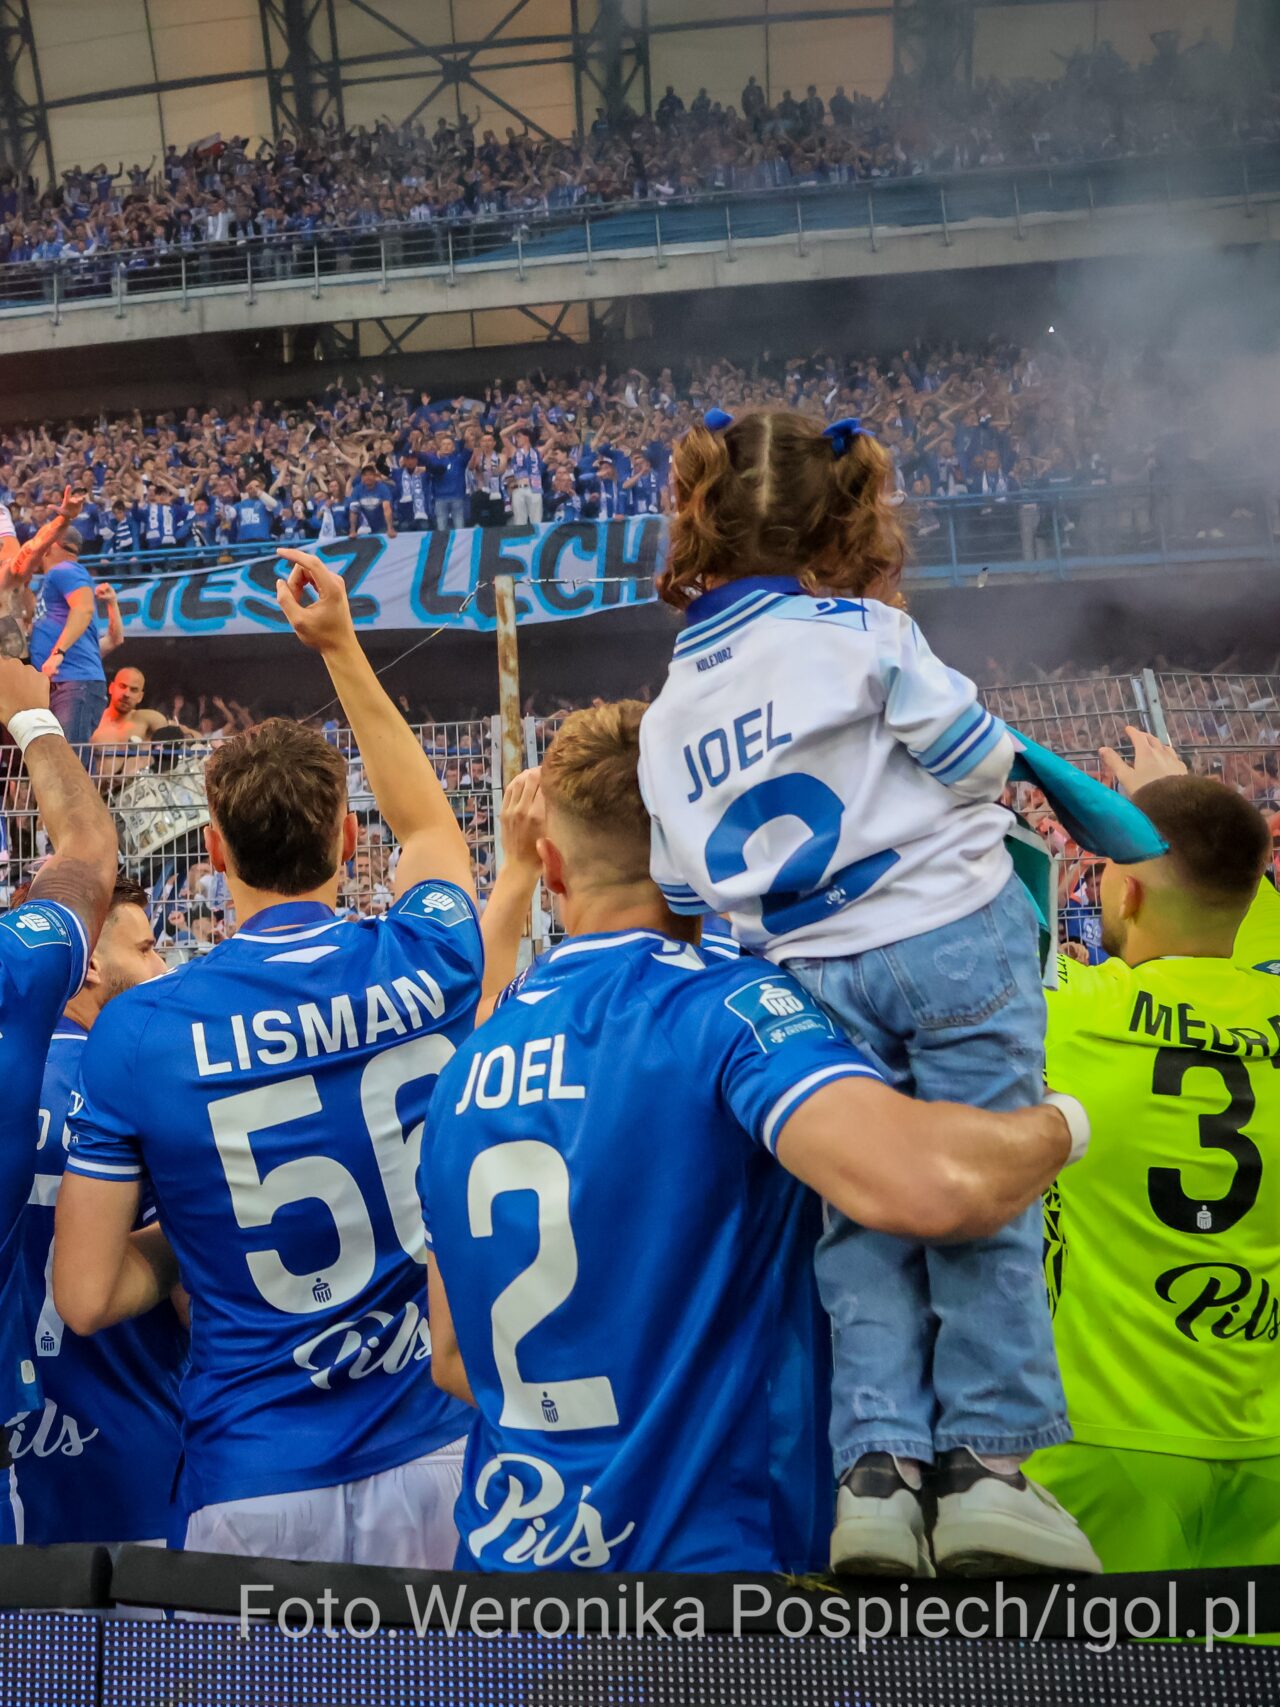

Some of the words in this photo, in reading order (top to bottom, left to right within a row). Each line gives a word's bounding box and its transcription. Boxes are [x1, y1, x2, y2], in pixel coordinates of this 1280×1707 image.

[410, 516, 668, 632] LECH
[682, 700, 794, 804] JOEL
[704, 771, 902, 936] 2
[191, 969, 446, 1077] LISMAN
[455, 1033, 586, 1115] JOEL
[207, 1033, 457, 1314] 56
[1148, 1046, 1280, 1234] 3
[467, 1139, 620, 1432] 2
[4, 1397, 99, 1459] ils
